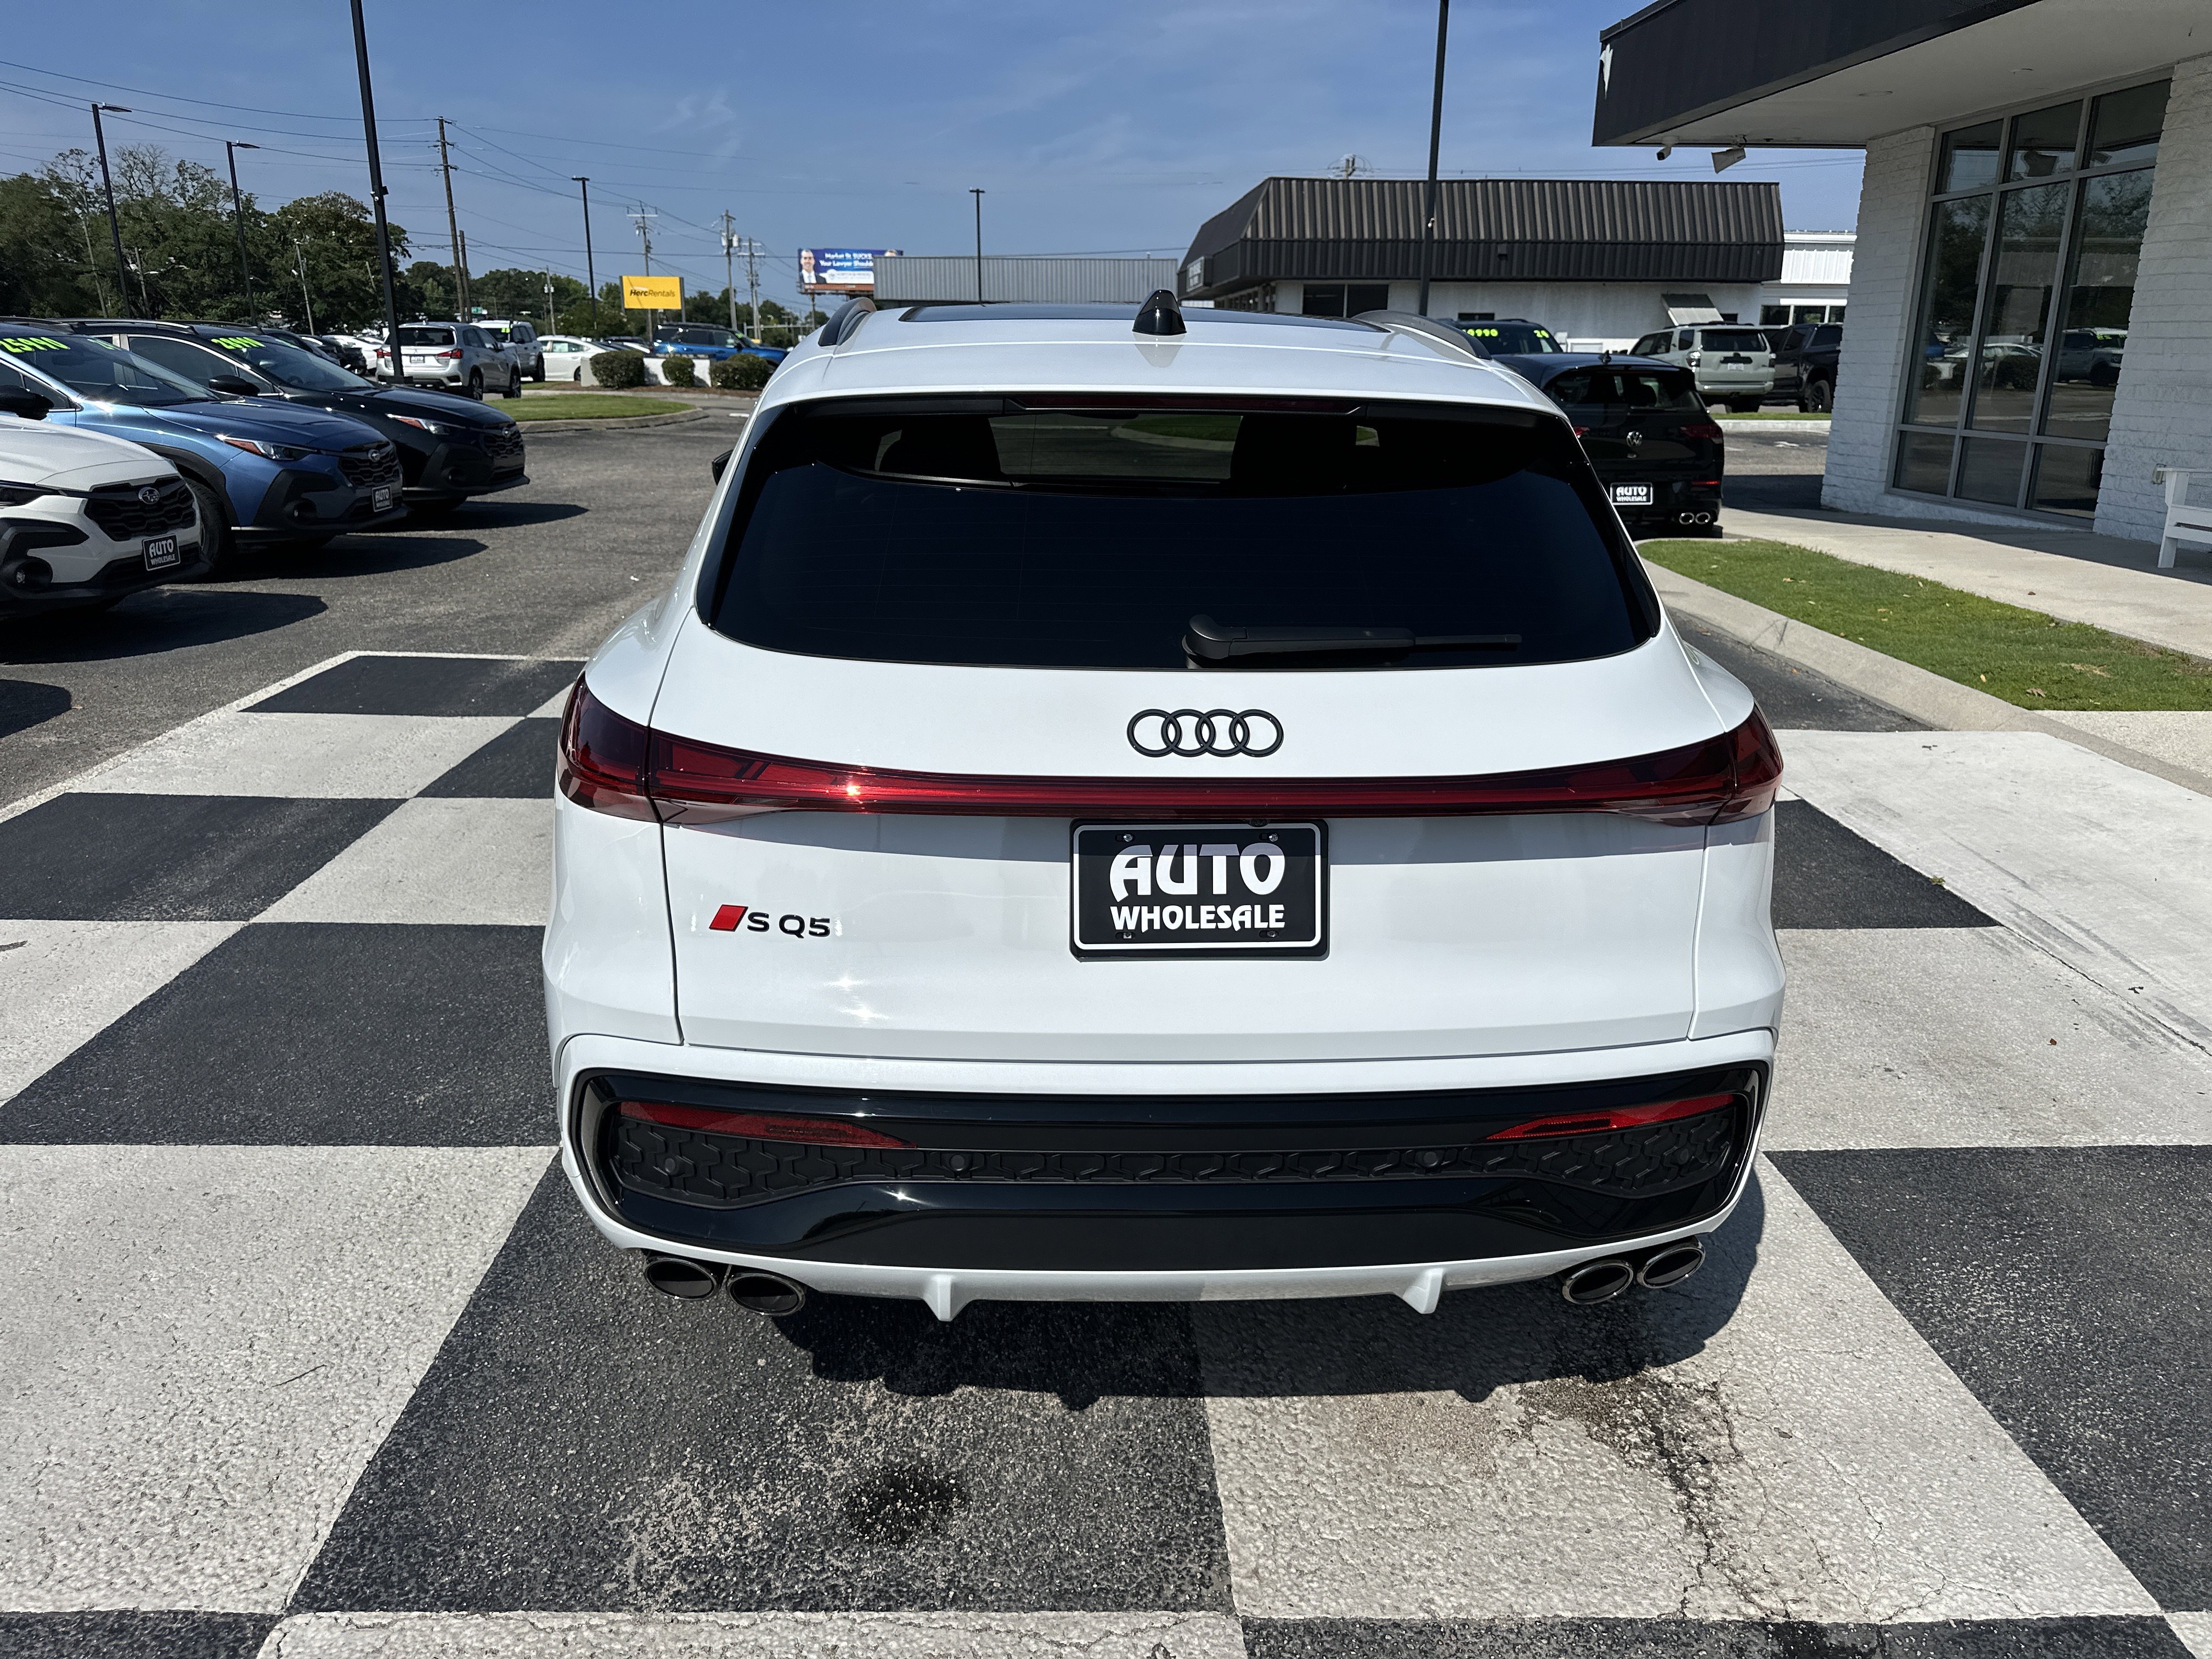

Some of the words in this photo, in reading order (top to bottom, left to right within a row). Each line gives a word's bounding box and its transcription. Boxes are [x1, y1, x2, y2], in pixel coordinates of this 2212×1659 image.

[375, 488, 390, 502] AUTO
[1616, 486, 1647, 496] AUTO
[149, 539, 174, 558] AUTO
[1109, 842, 1285, 902] AUTO
[1109, 904, 1285, 933] WHOLESALE
